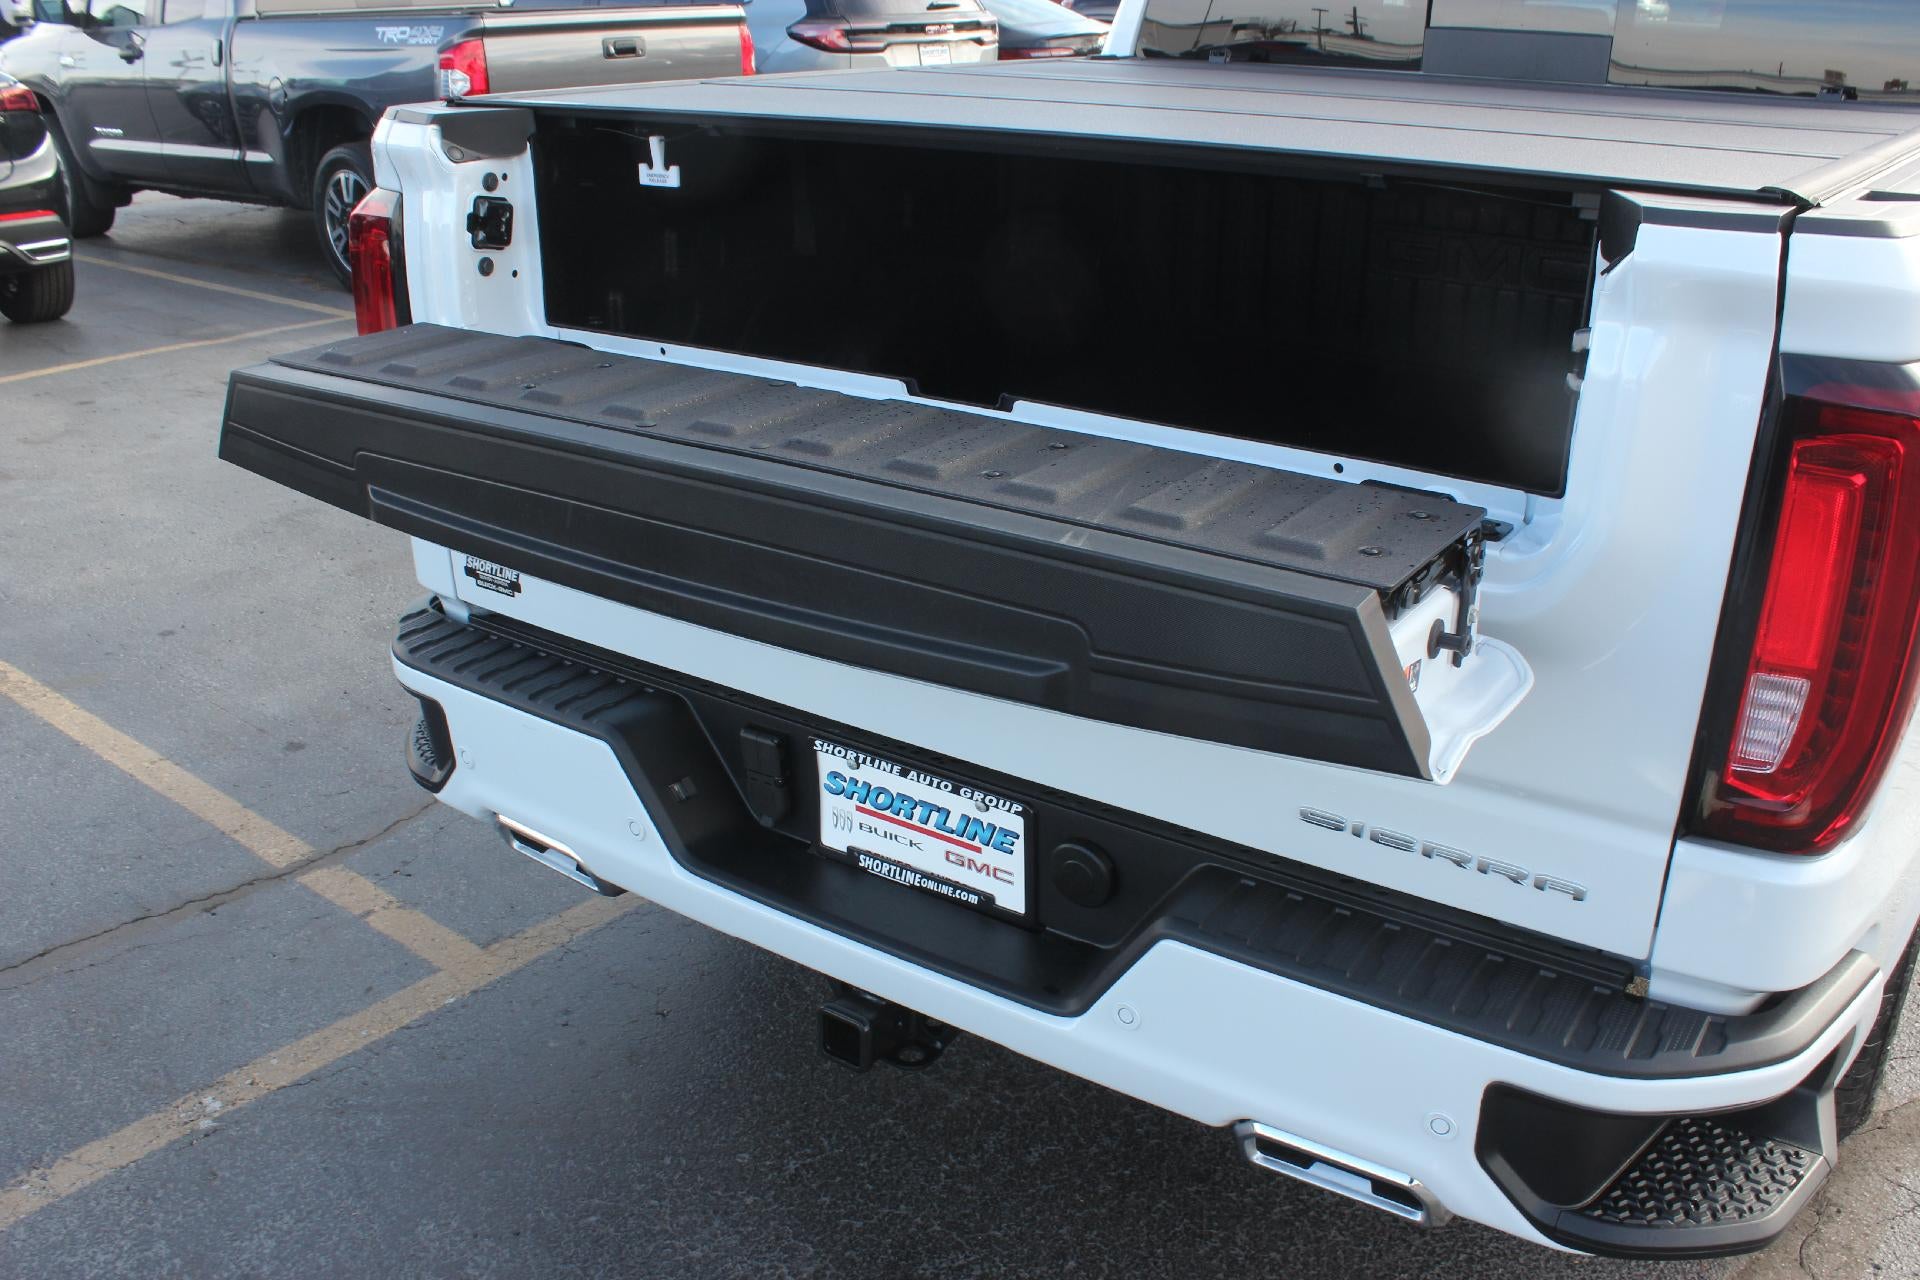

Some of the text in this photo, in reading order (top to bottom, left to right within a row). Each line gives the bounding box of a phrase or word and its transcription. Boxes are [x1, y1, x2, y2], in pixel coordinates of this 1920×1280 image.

[466, 556, 519, 582] SHORTLINE
[813, 740, 1023, 815] SHORTLINE AUTO GROUP
[823, 770, 1020, 855] SHORTLINE
[858, 822, 924, 851] BUICK
[944, 850, 1015, 886] GMC
[1299, 805, 1587, 902] SIERRA
